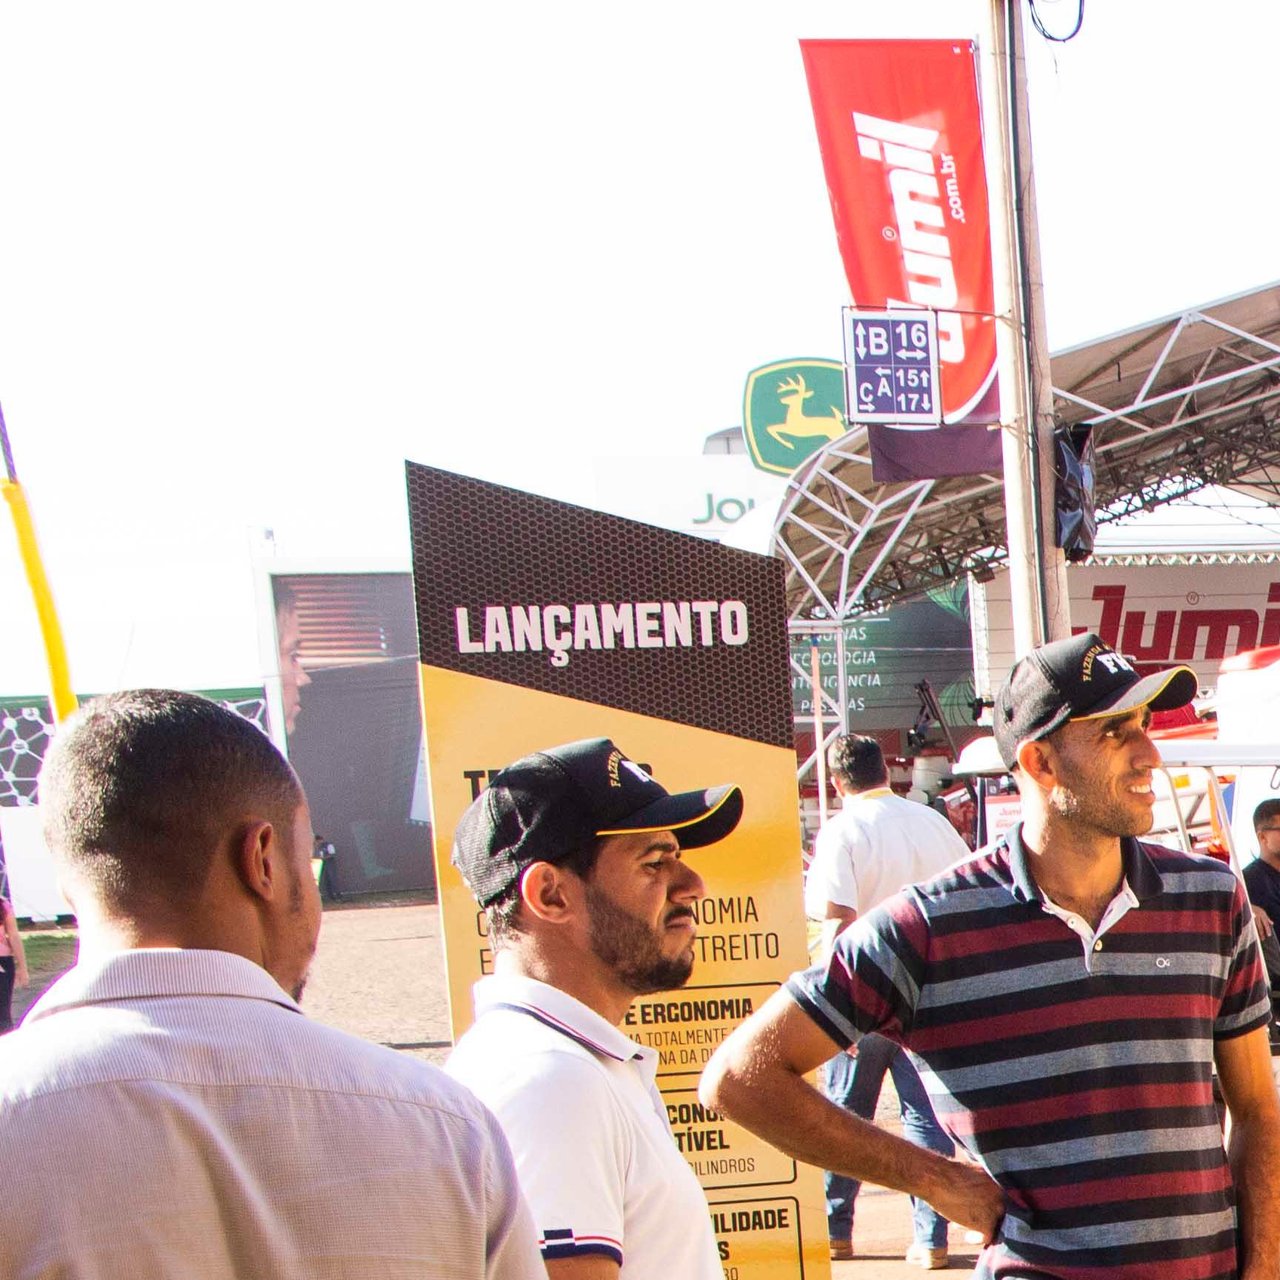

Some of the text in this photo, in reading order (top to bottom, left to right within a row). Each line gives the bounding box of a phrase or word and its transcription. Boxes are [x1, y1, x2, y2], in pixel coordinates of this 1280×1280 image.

[940, 153, 965, 223] .com.br
[869, 327, 889, 355] B
[895, 322, 927, 348] 16
[877, 377, 892, 397] A
[896, 368, 919, 387] 15
[859, 382, 873, 402] C
[897, 393, 919, 411] 17
[454, 600, 749, 667] LANÇAMENTO
[641, 998, 753, 1024] ERGONOMIA
